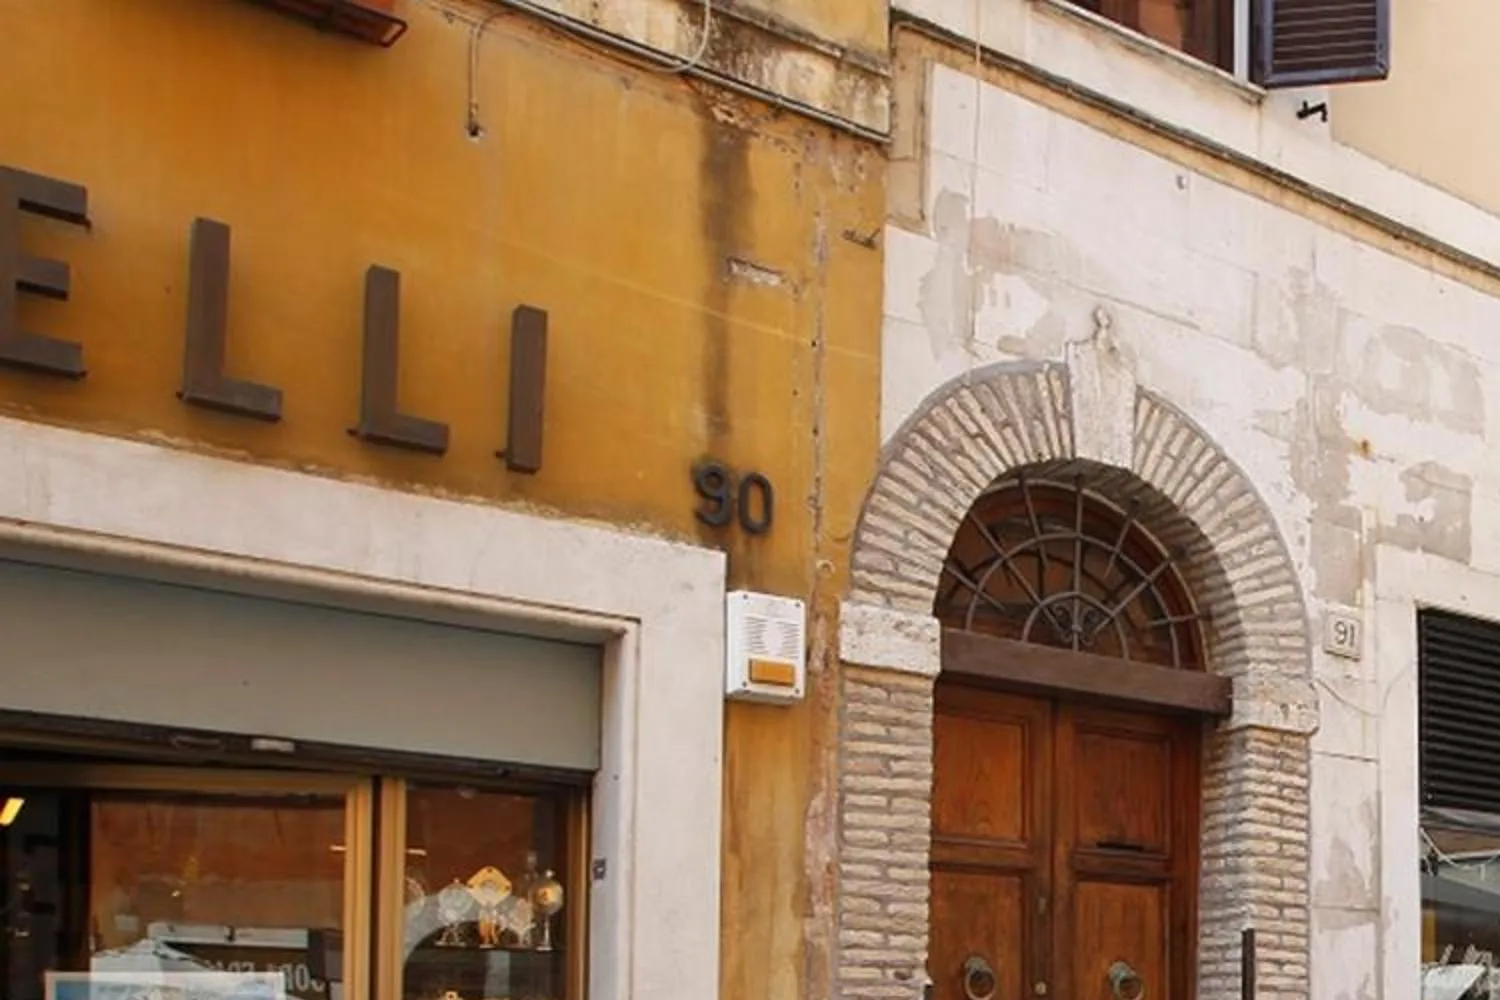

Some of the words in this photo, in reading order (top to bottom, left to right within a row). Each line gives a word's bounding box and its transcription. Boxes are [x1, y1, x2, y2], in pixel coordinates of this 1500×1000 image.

[0, 165, 548, 474] ELLI
[692, 458, 774, 535] 90
[1333, 620, 1355, 648] 91
